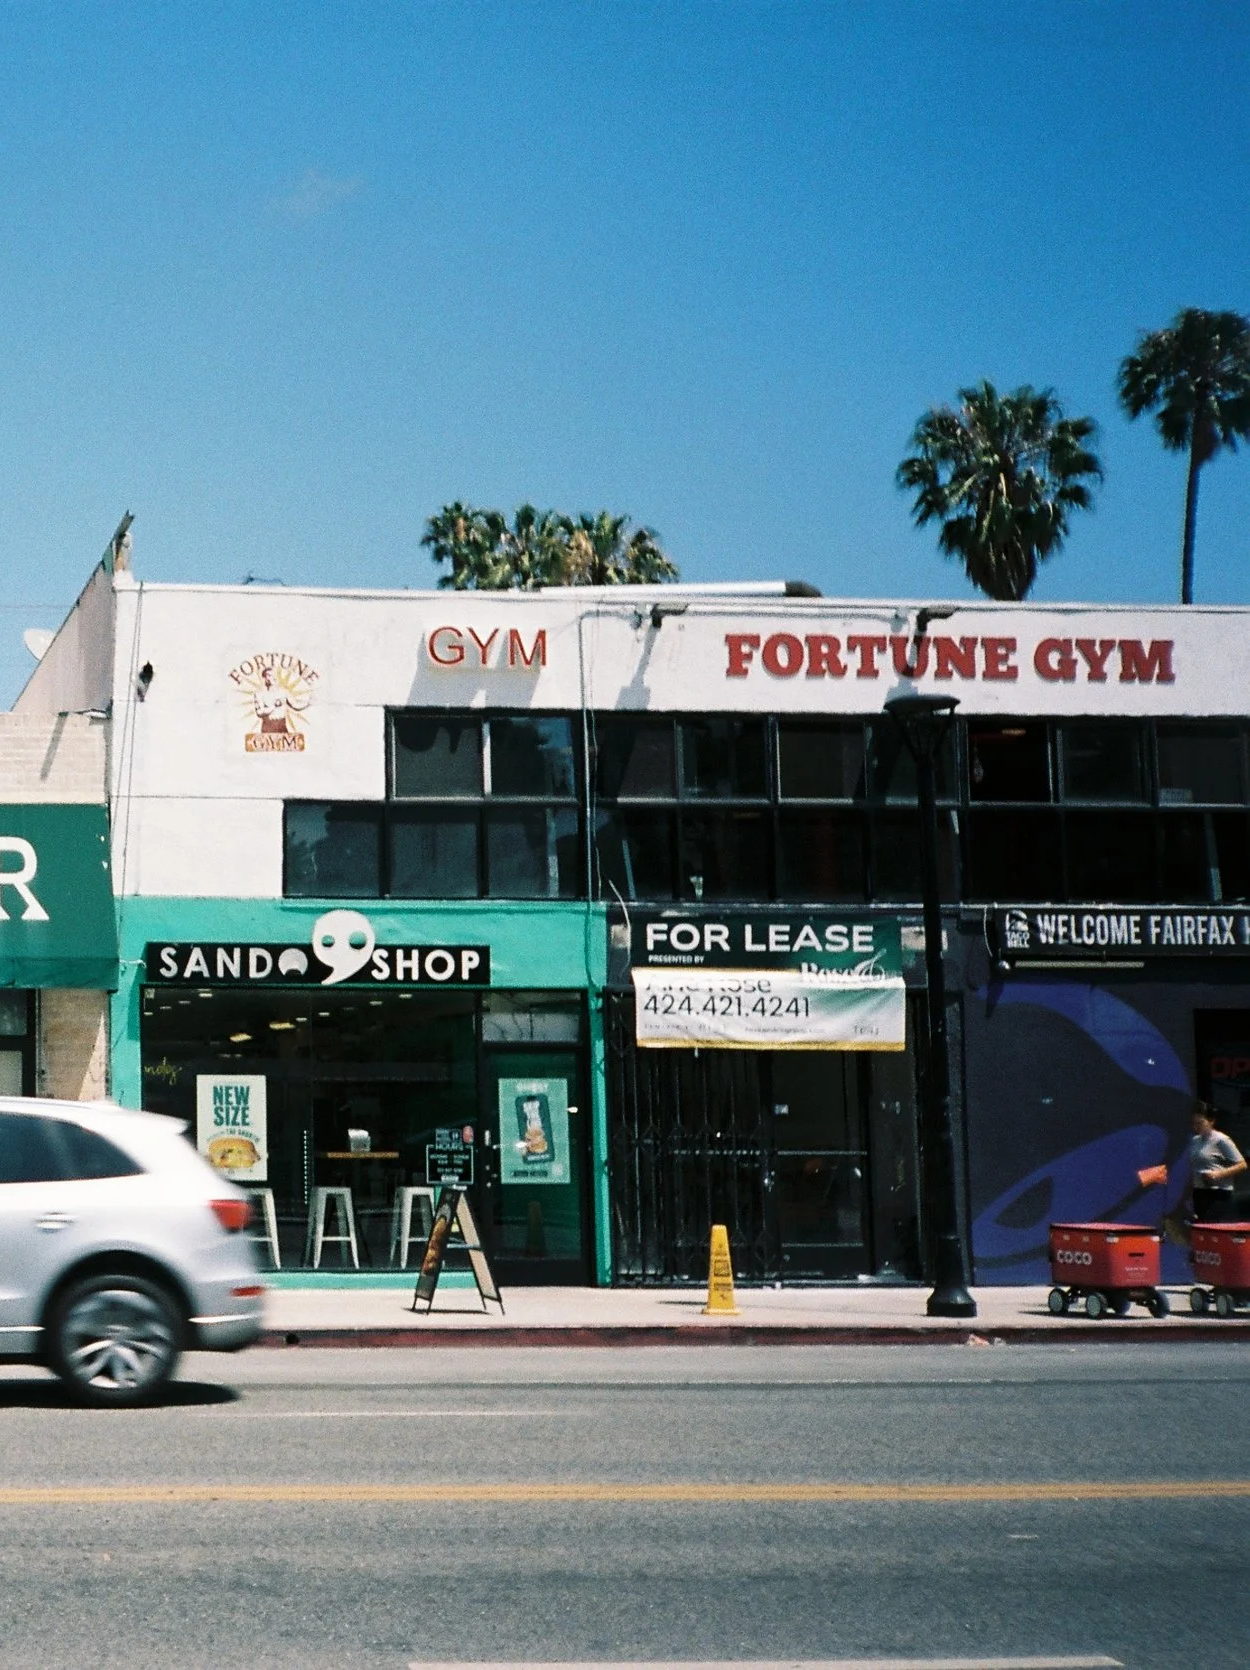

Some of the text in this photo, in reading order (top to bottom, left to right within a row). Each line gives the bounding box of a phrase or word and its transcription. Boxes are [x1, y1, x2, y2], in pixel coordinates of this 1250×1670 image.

[428, 626, 548, 668] GYM
[725, 632, 1176, 684] FORTUNE GYM
[229, 652, 319, 685] FORTUNE
[253, 734, 298, 750] GYM
[646, 923, 874, 952] FOR LEASE
[1037, 914, 1142, 945] WELCOME
[1150, 915, 1236, 945] FAIRFAX
[371, 949, 481, 981] SHOP
[648, 954, 704, 964] PRESENTED BY
[644, 994, 810, 1018] 424.421.4241
[213, 1085, 250, 1106] NEW
[214, 1106, 250, 1126] SIZE
